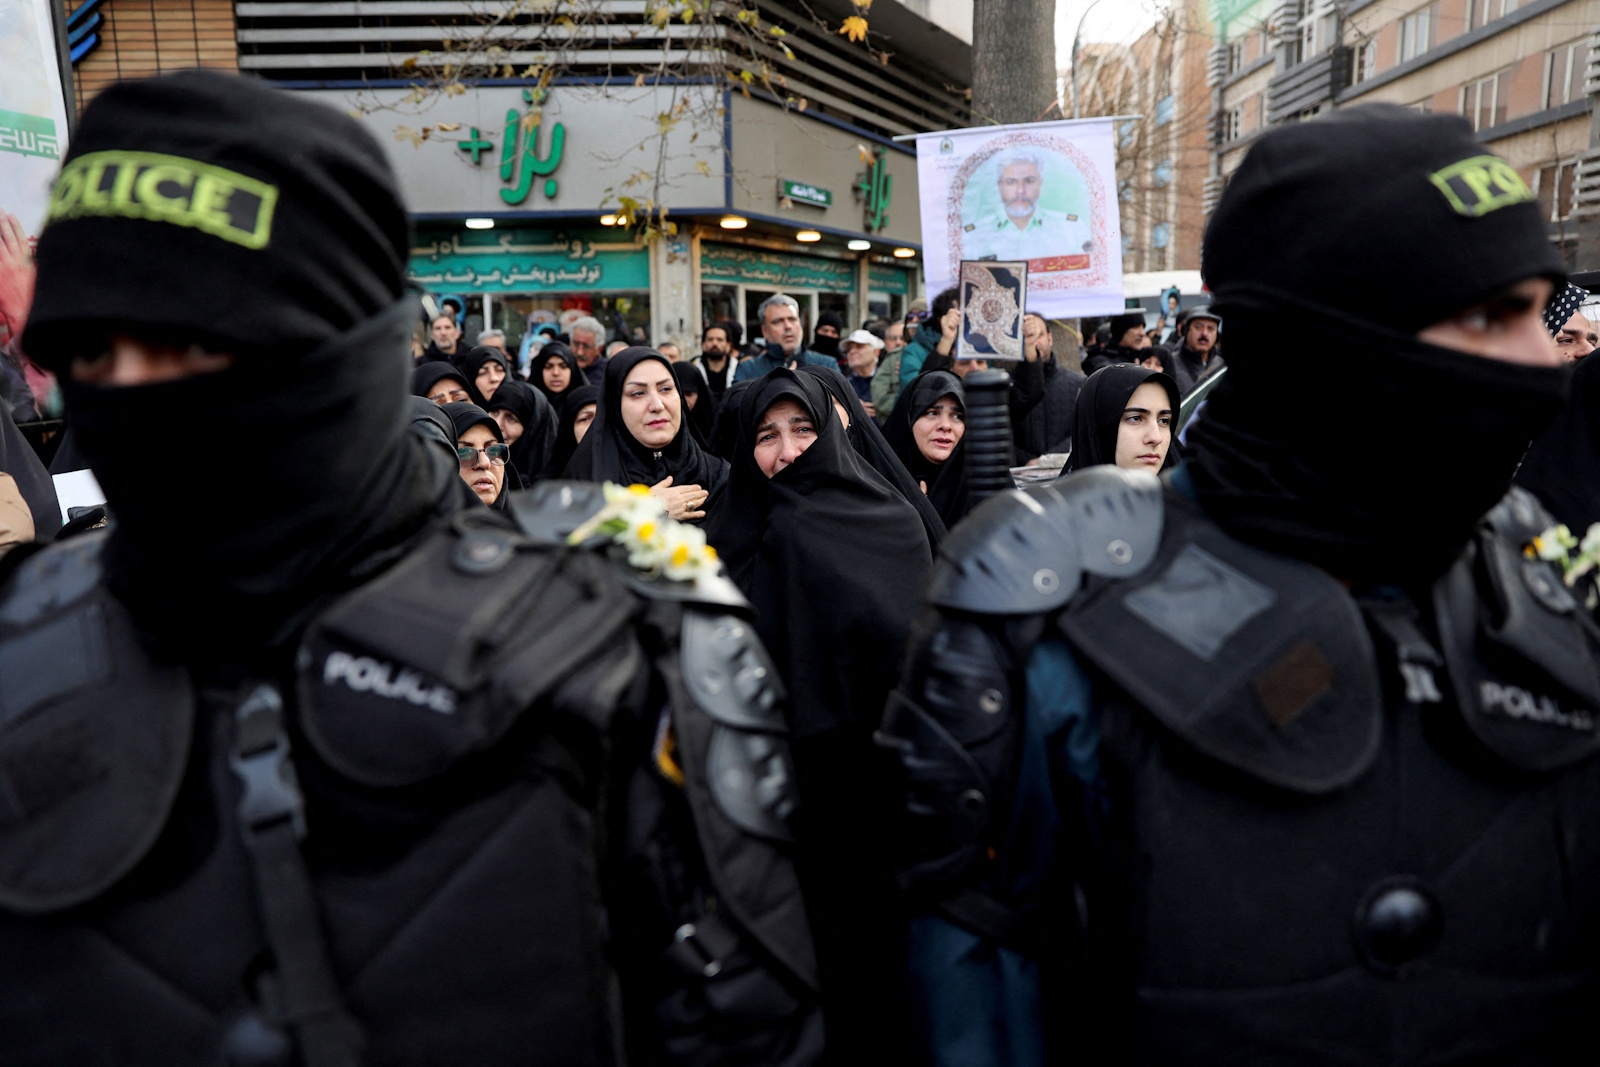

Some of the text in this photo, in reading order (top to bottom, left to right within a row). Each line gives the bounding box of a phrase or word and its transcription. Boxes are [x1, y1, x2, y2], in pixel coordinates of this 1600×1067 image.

[50, 158, 236, 229] OLICE
[1460, 161, 1532, 206] PO
[323, 650, 457, 716] POLICE
